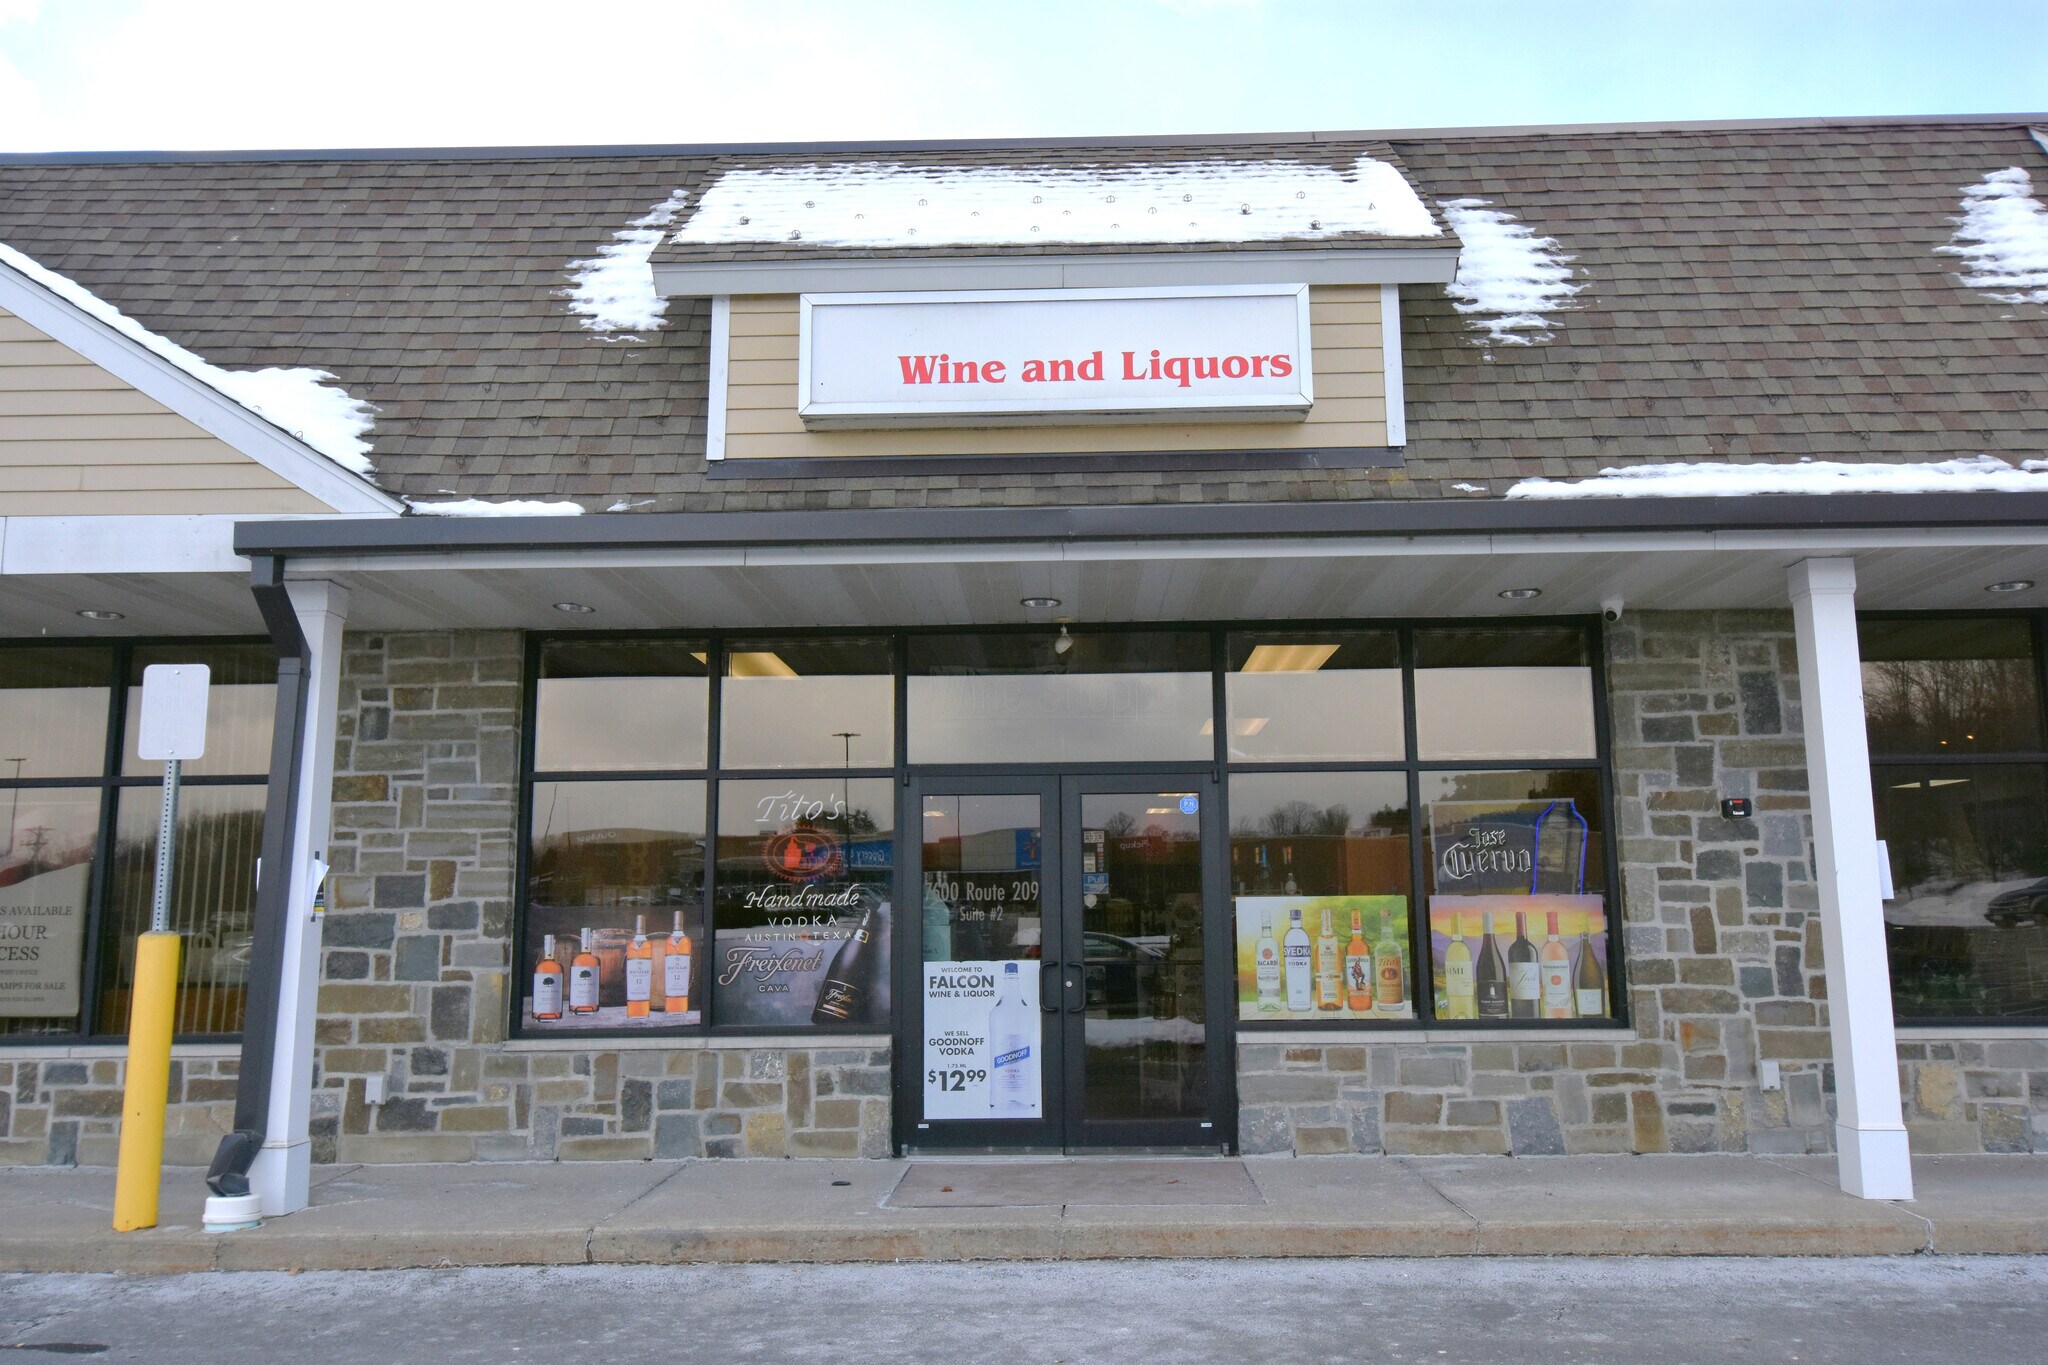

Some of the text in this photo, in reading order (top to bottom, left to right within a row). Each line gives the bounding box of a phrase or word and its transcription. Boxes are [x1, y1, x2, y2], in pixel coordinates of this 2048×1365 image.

[898, 349, 1293, 388] Wine and Liquors
[754, 790, 846, 822] Tito's
[1443, 843, 1531, 880] Cuervo
[1087, 875, 1105, 884] Pull
[743, 884, 860, 909] Handmade
[966, 882, 1006, 901] Route
[1012, 882, 1040, 901] 209
[9, 906, 73, 916] AVAILABLE
[960, 906, 1004, 921] Suite #2
[767, 914, 838, 929] VODKA
[744, 932, 797, 943] AUSTIN
[717, 945, 825, 986] Freixenet
[758, 985, 790, 994] CAVA
[929, 975, 995, 989] FALCON
[928, 989, 995, 998] WINE & LIQUOR
[928, 1038, 985, 1047] GOODNOFF
[939, 1047, 975, 1056] VODKA
[996, 1048, 1028, 1064] GOODNOFF
